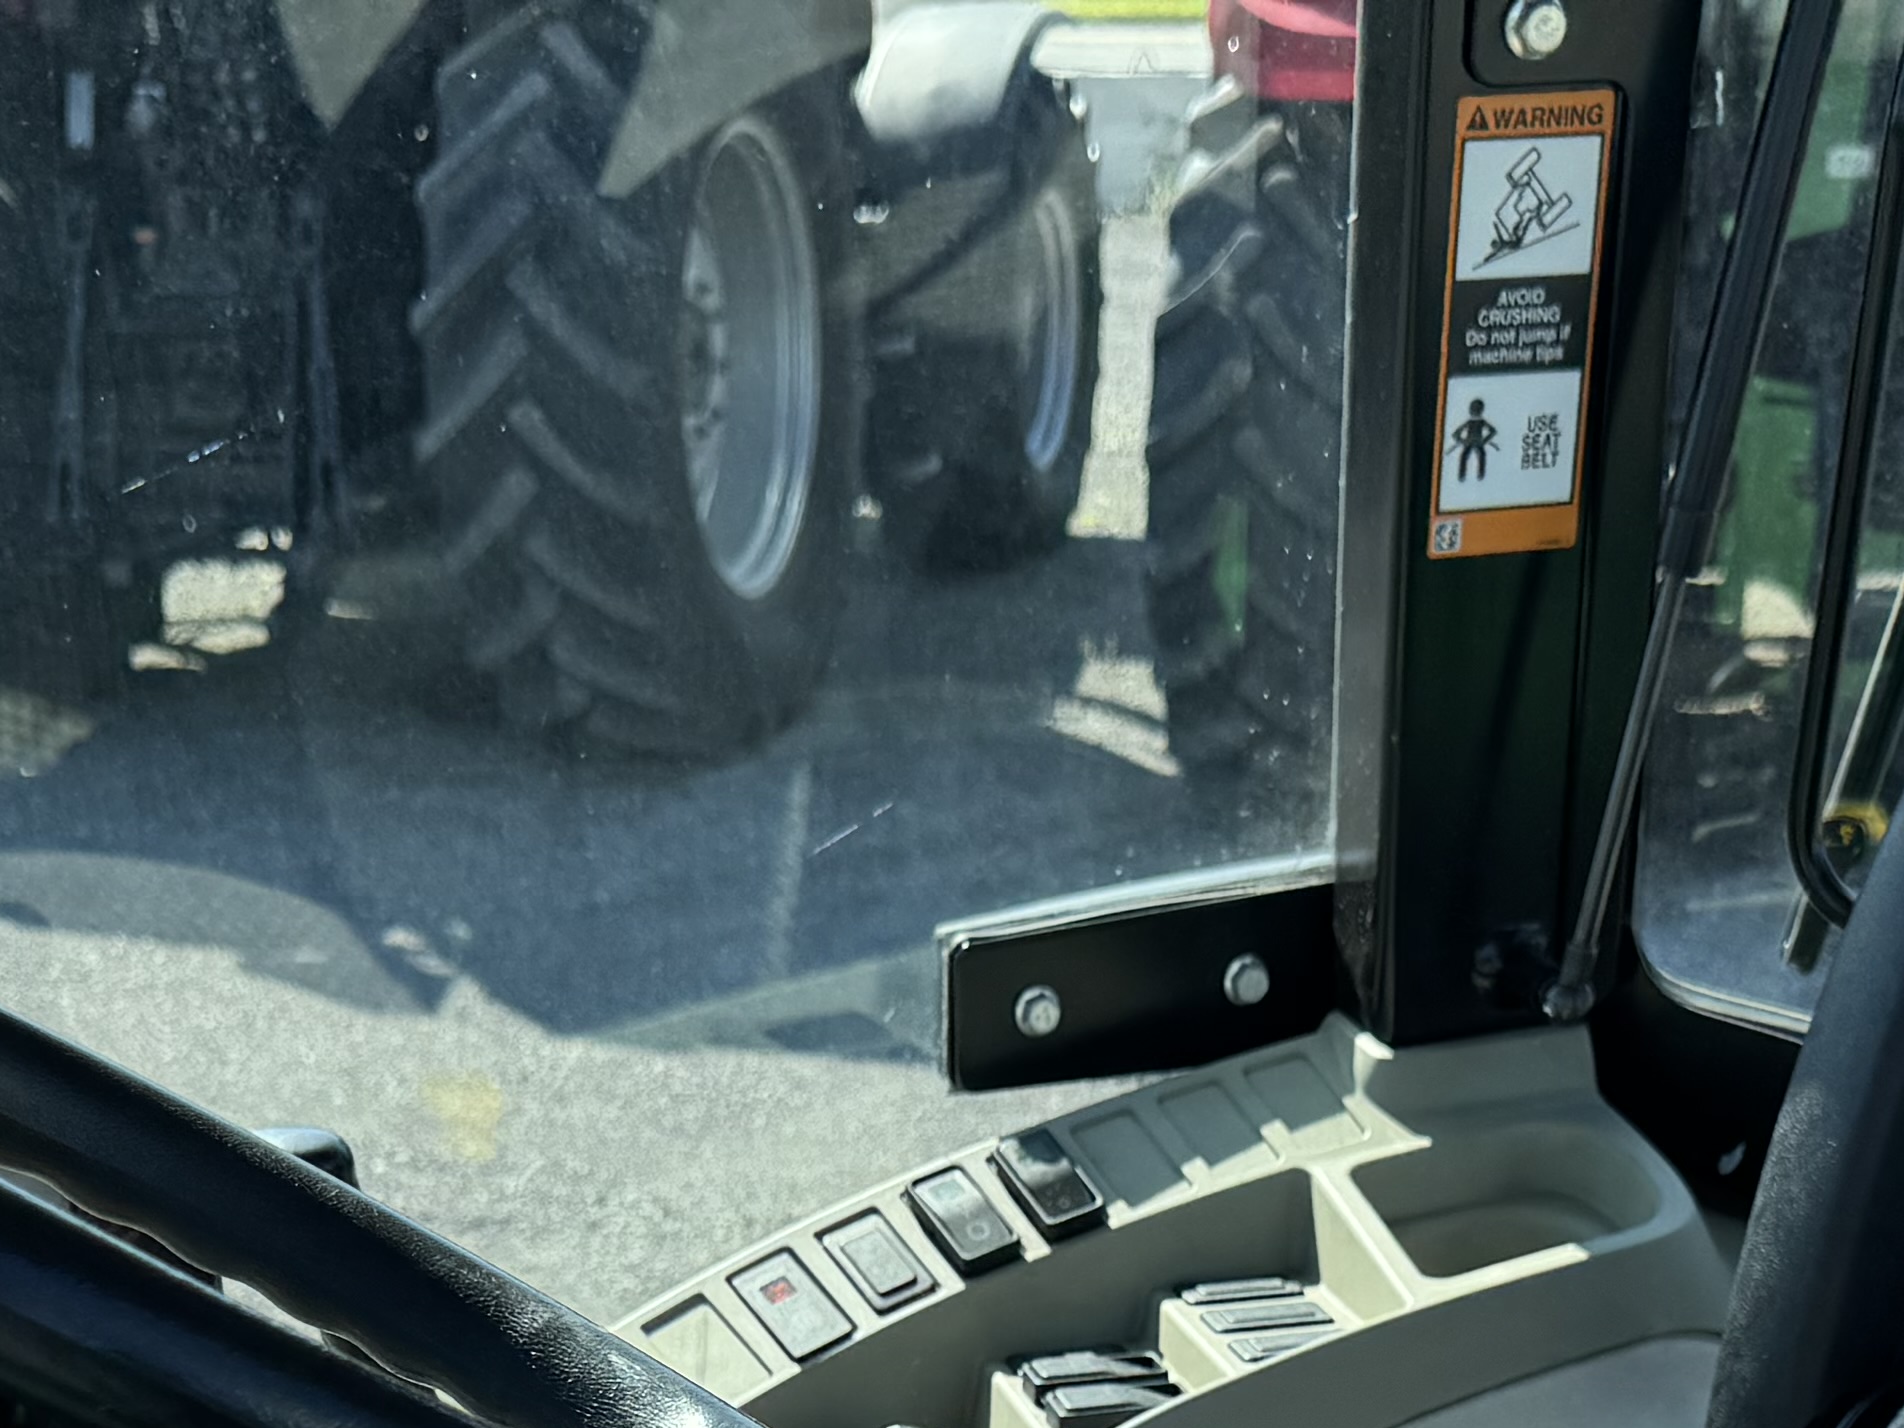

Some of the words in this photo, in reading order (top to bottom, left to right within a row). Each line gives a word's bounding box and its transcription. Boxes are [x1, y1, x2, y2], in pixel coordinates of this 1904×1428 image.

[1493, 104, 1604, 130] WARNING
[1497, 286, 1545, 307] AVOID
[1477, 304, 1561, 328] CRUSHING
[1465, 328, 1488, 347] Do
[1491, 327, 1516, 345] not
[1518, 325, 1557, 347] jump
[1559, 322, 1571, 340] if
[1469, 346, 1534, 365] machine
[1536, 344, 1564, 365] tips
[1527, 413, 1559, 433] USE
[1522, 431, 1561, 451] SEAT
[1521, 452, 1558, 471] BELT
